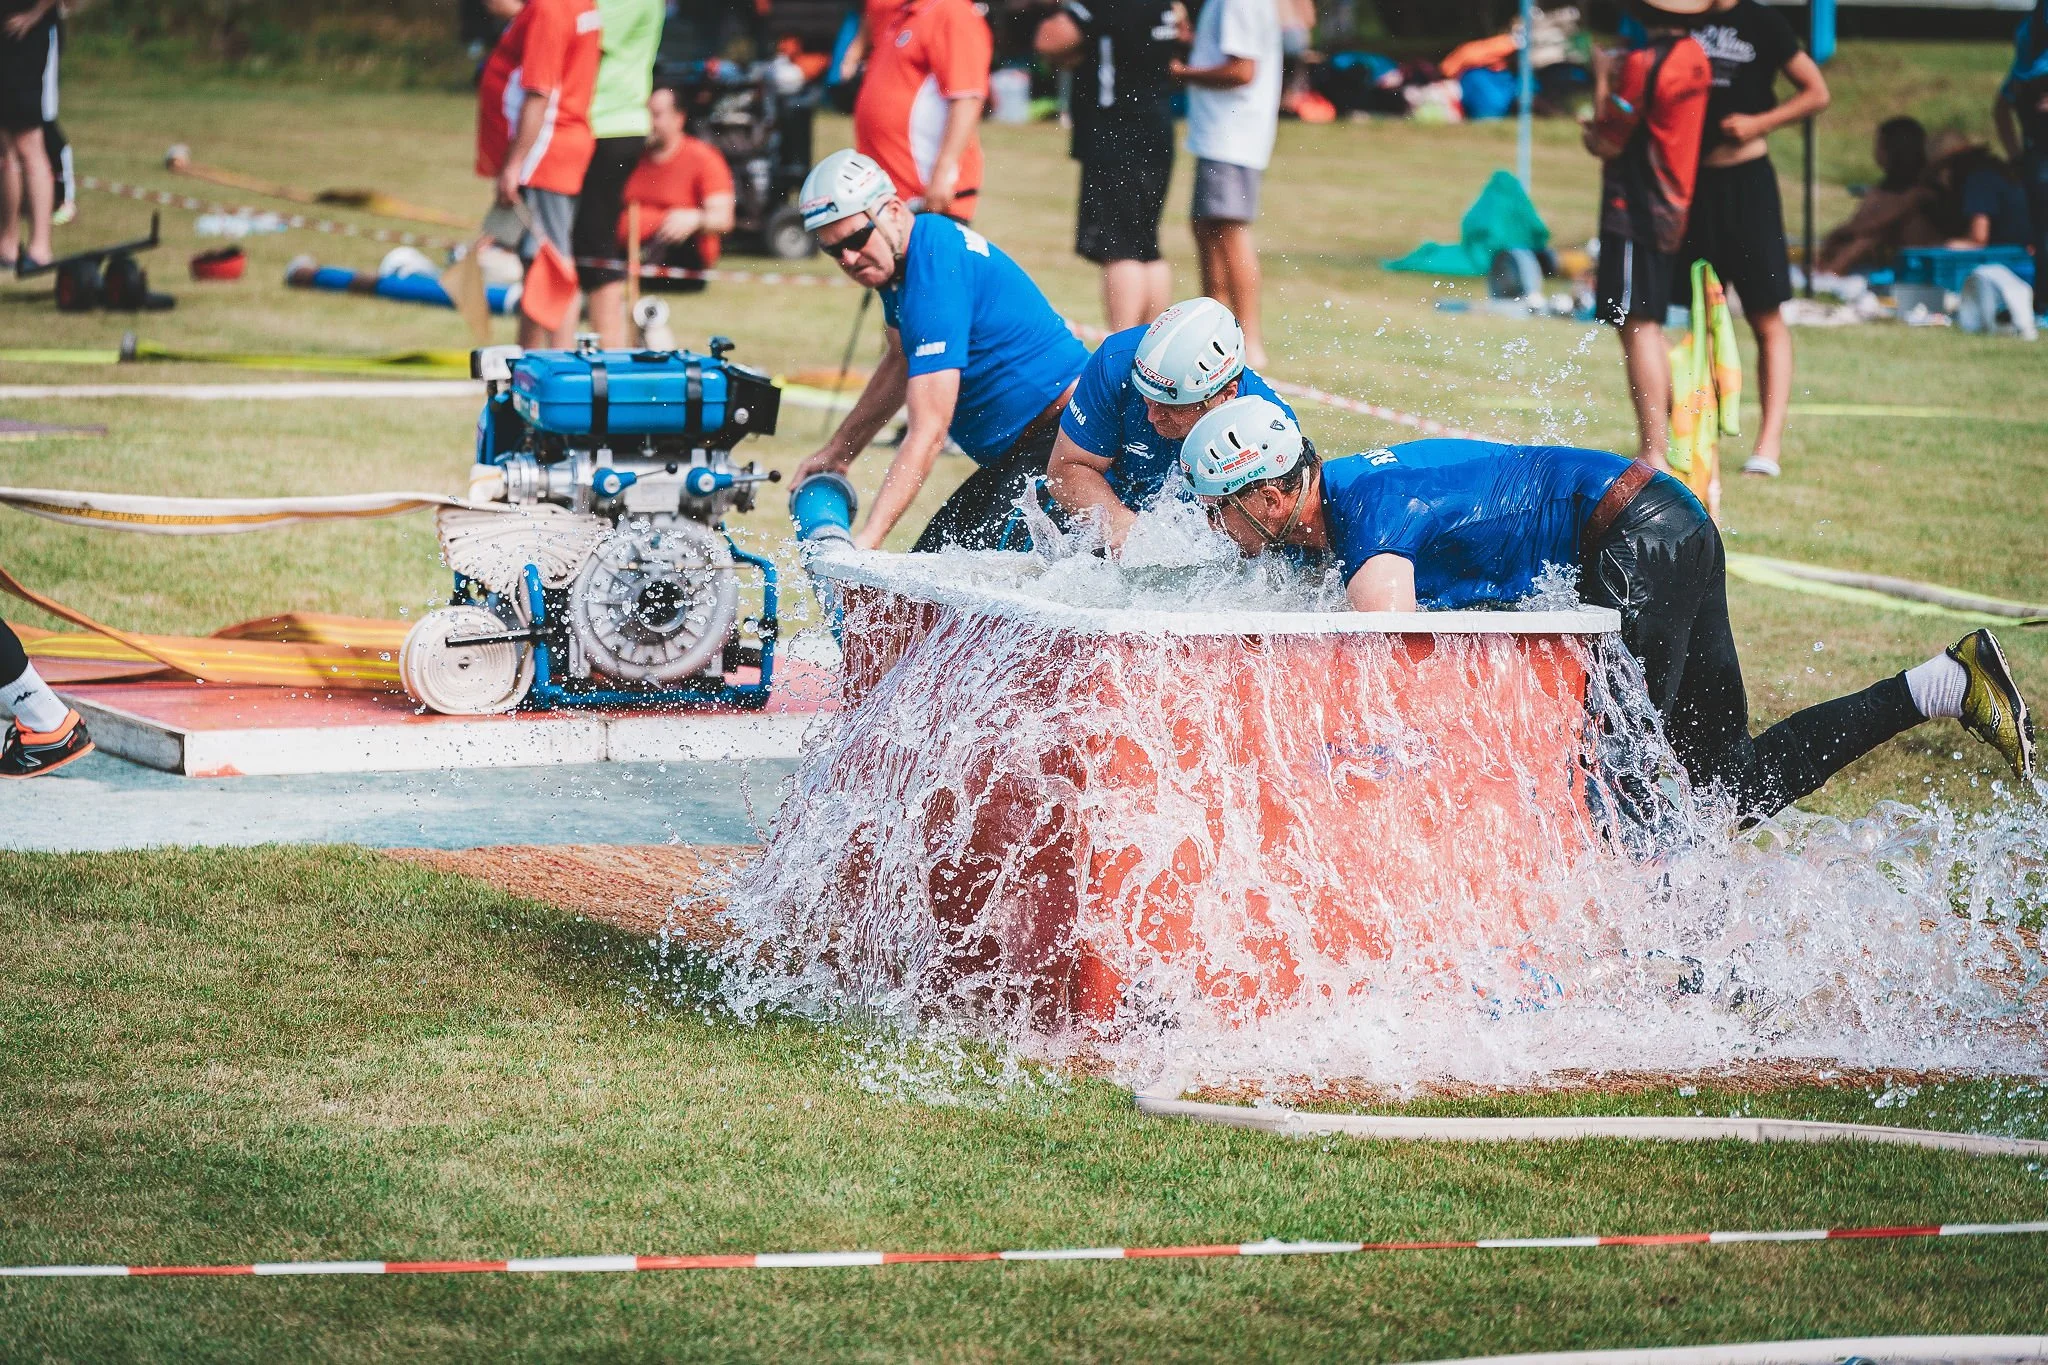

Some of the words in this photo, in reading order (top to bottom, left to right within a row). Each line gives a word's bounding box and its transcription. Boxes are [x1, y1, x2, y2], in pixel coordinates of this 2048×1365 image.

[1217, 455, 1239, 473] Jarbas
[1225, 475, 1246, 489] Fany
[1247, 464, 1267, 479] Cars
